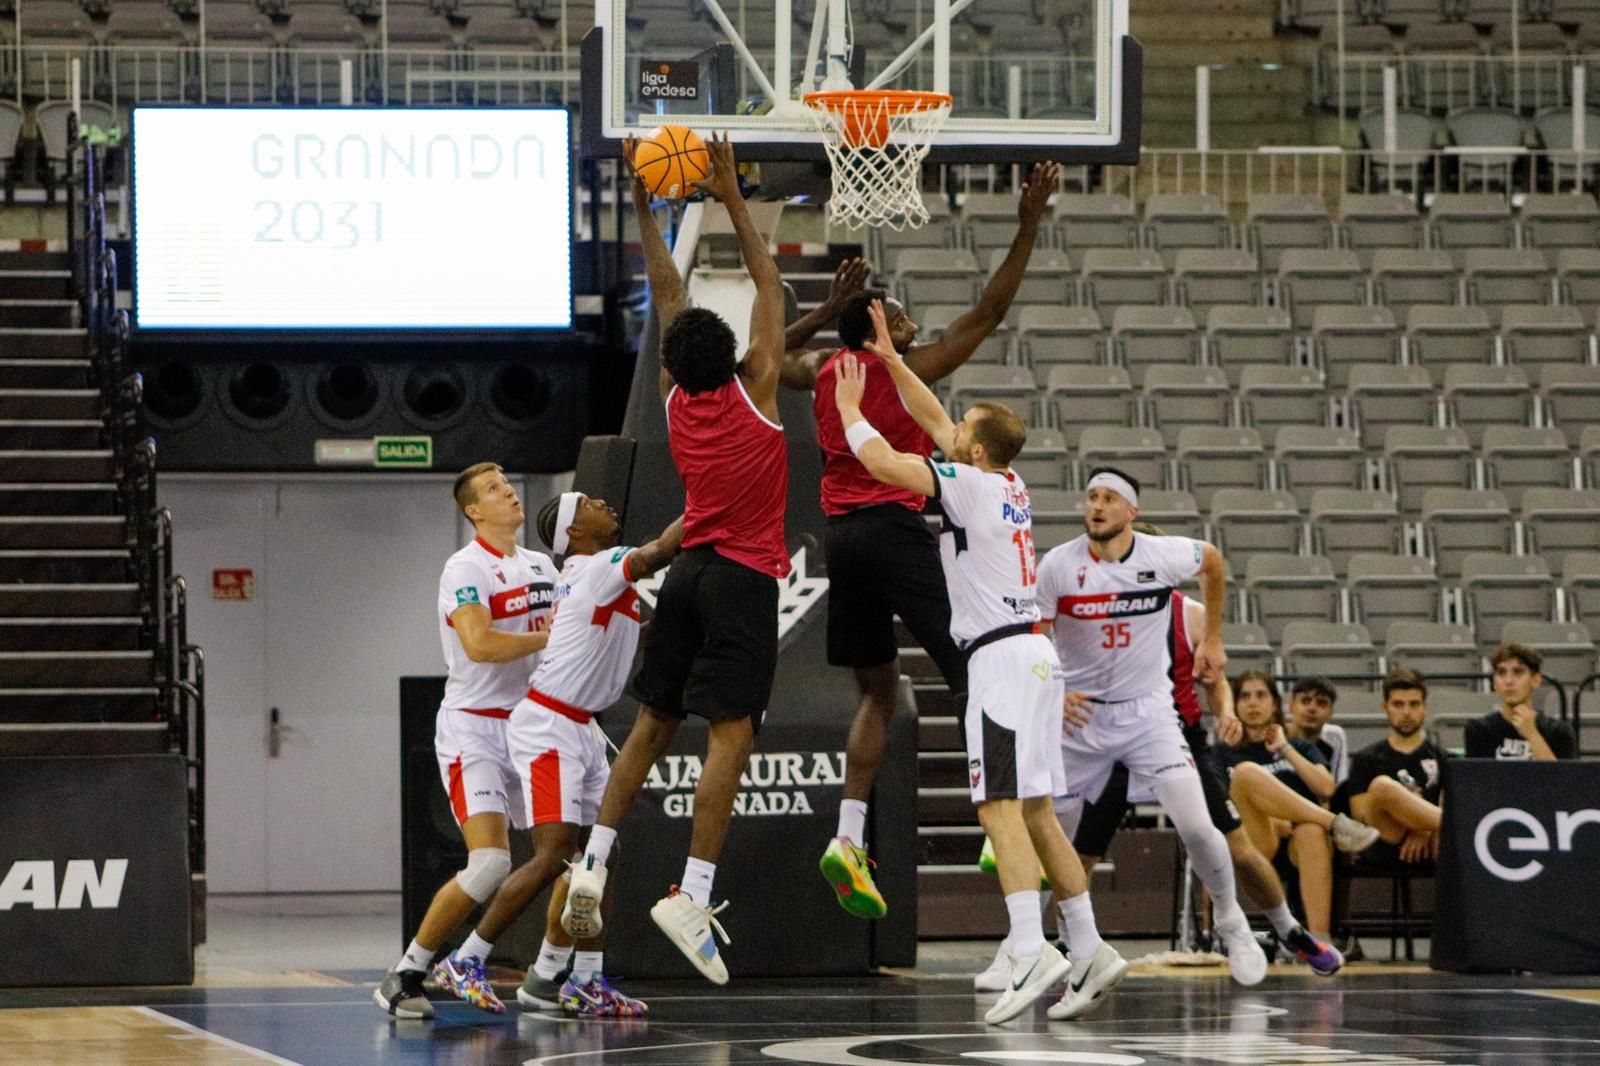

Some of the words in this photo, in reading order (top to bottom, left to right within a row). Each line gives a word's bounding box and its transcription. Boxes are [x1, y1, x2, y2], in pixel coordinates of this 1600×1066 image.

[642, 71, 667, 85] liga
[642, 84, 696, 97] endesa
[251, 133, 546, 180] GRANADA
[253, 199, 385, 249] 2031
[380, 445, 426, 457] SALIDA
[1101, 623, 1131, 649] 35
[642, 755, 704, 790] AJA
[664, 791, 814, 818] GNADA
